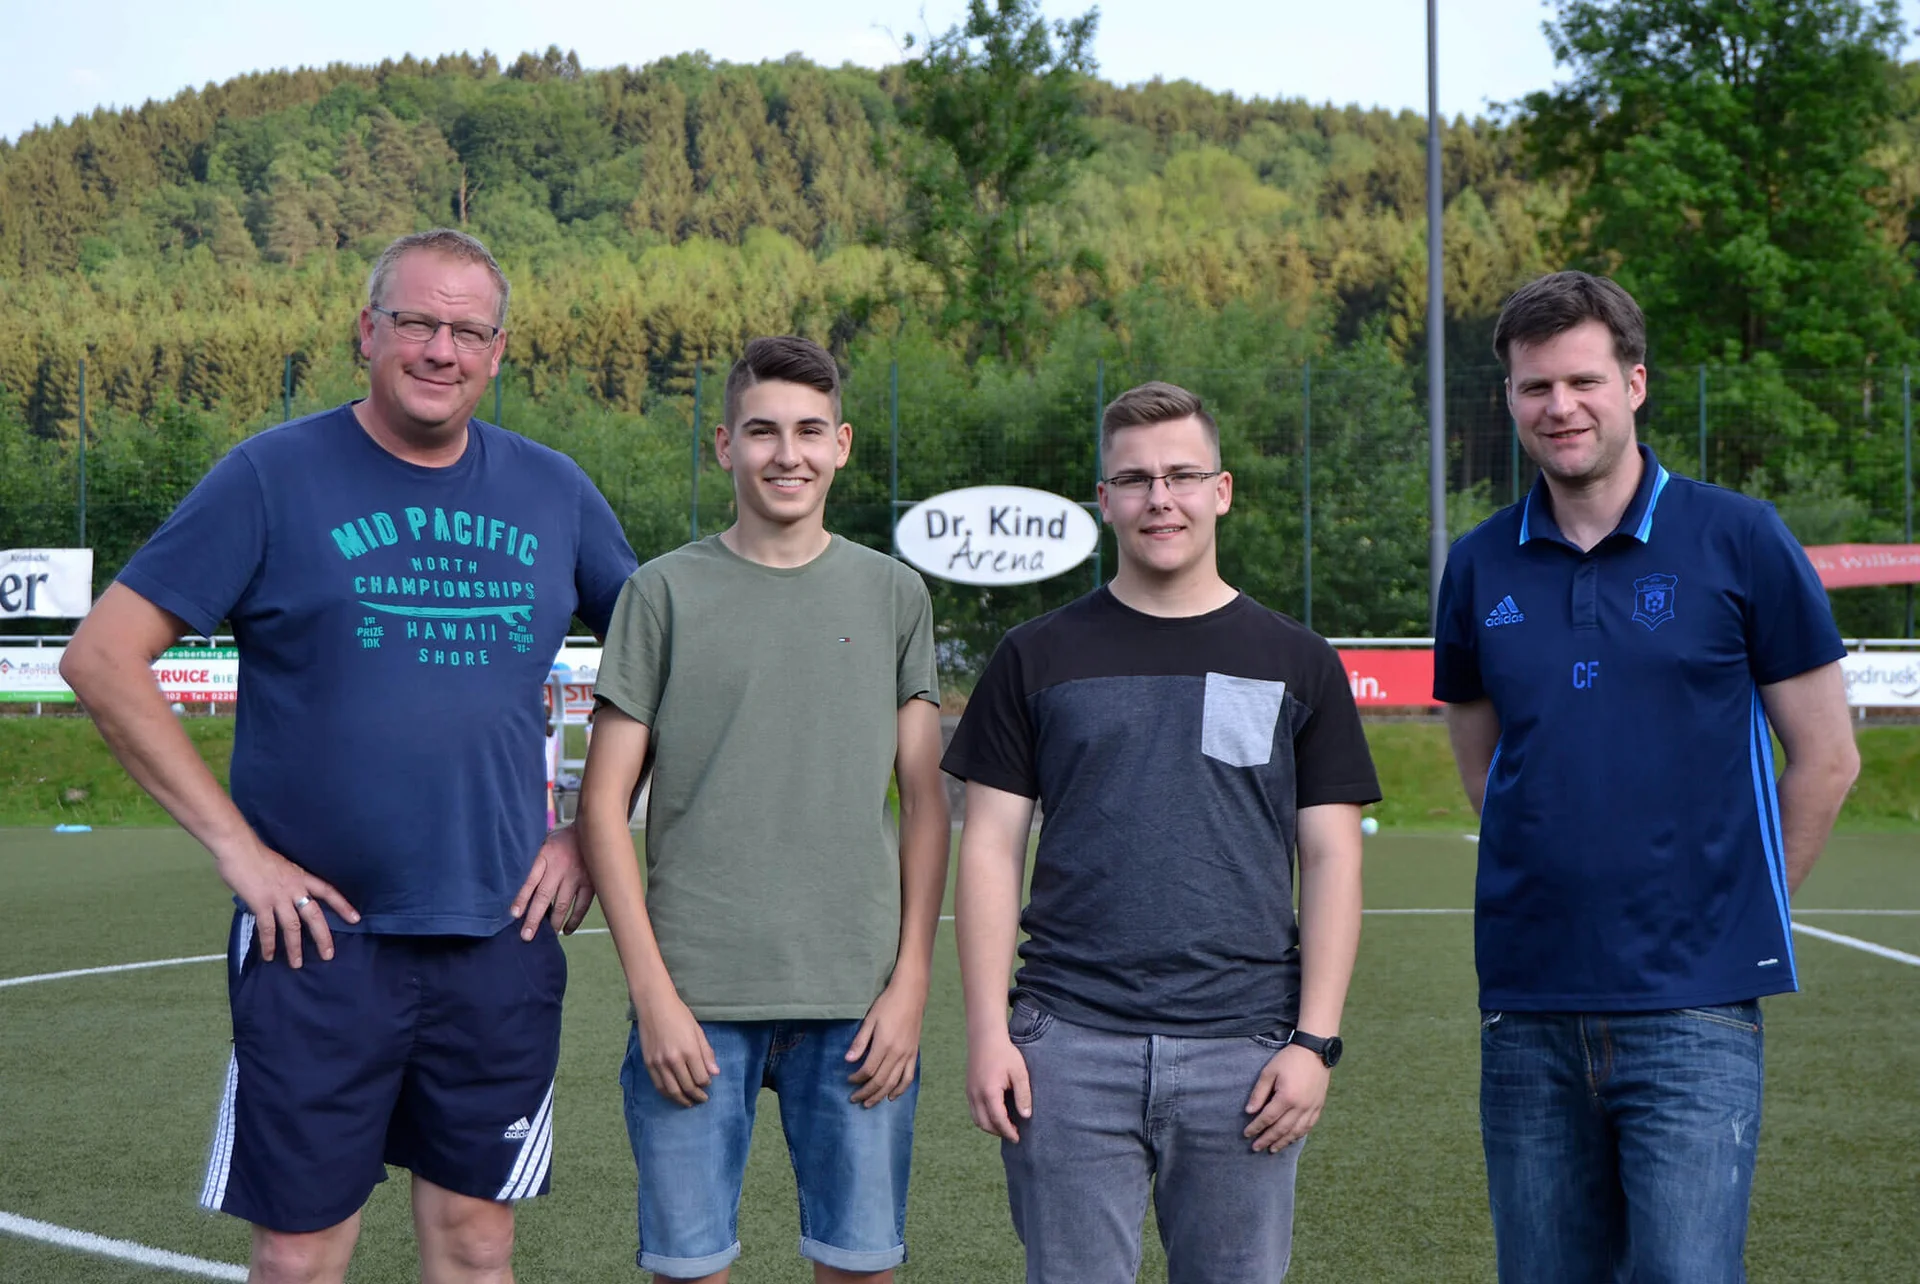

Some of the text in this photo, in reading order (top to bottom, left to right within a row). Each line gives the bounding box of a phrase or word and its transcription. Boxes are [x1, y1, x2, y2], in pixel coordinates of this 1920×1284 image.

[926, 505, 1067, 539] Dr. Kind
[331, 507, 538, 568] MID PACIFIC
[948, 537, 1045, 571] Arena
[411, 557, 477, 573] NORTH
[353, 576, 534, 599] CHAMPIONSHIPS
[1485, 612, 1525, 627] adidas
[356, 625, 384, 637] PRIZE
[407, 622, 496, 640] HAWAII
[362, 638, 380, 648] 10K
[418, 648, 488, 666] SHORE
[1573, 661, 1599, 688] CF
[192, 692, 209, 700] Tel.
